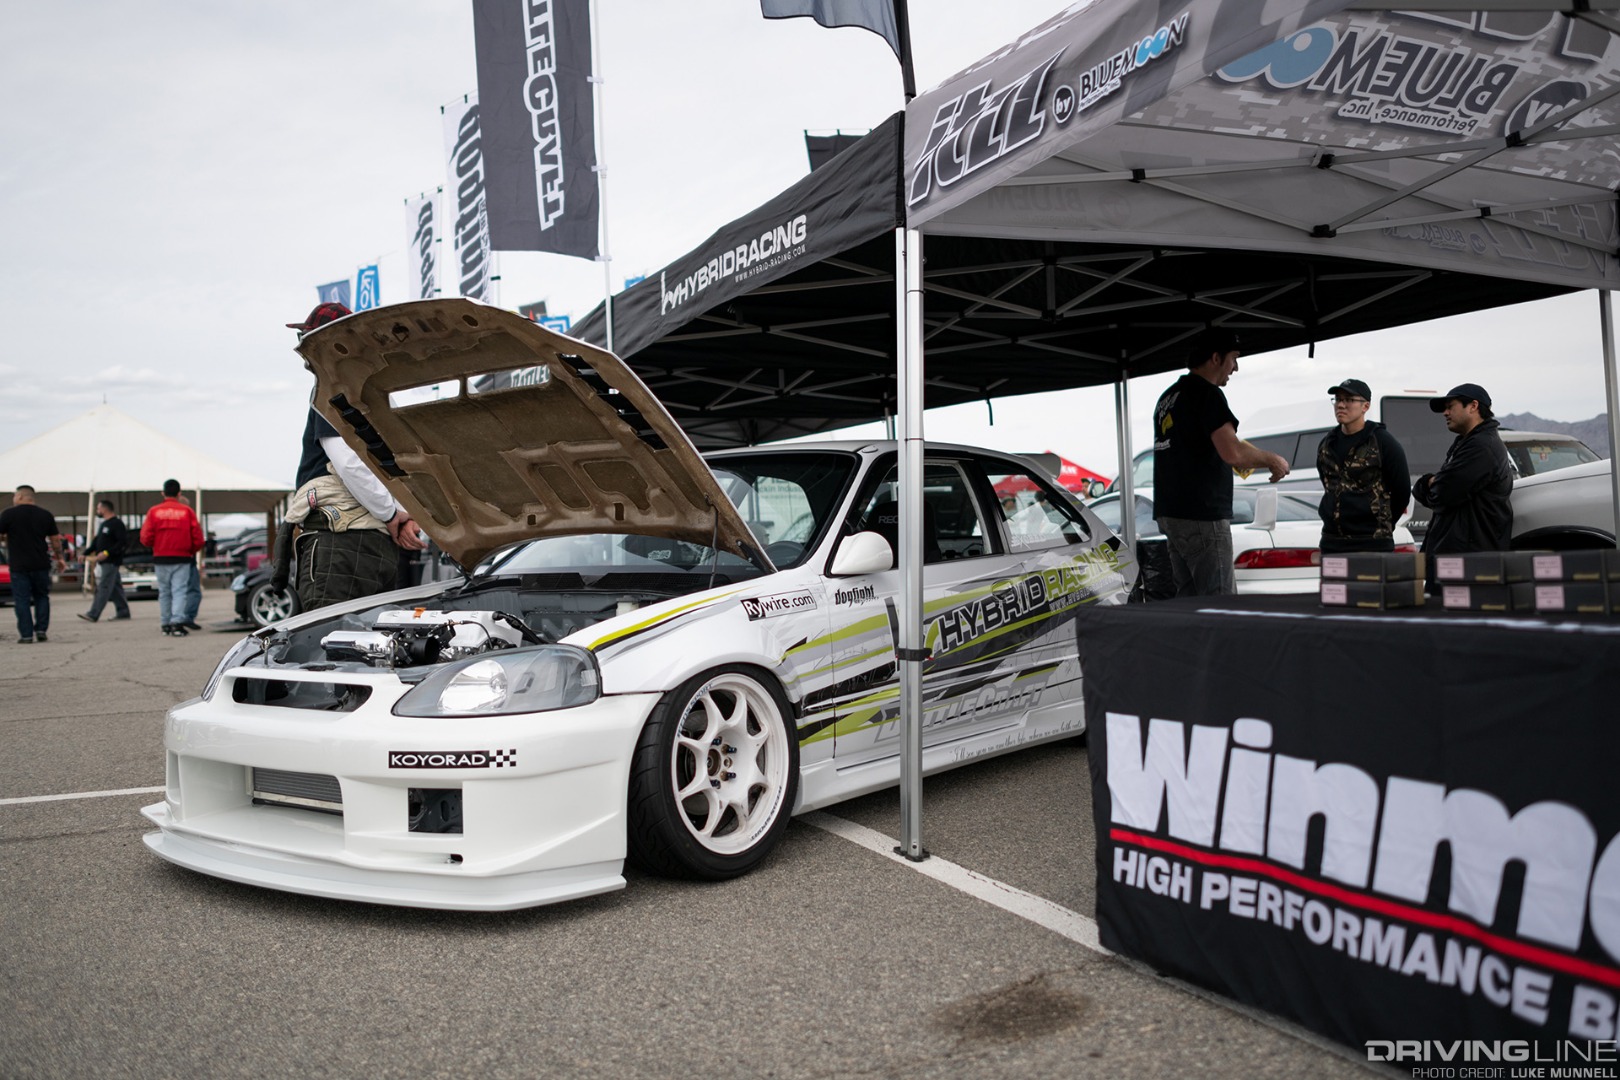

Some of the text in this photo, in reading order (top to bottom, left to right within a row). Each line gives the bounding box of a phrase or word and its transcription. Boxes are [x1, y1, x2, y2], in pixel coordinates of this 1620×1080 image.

[744, 594, 815, 617] Rywire.com
[834, 584, 874, 608] dogfight
[391, 754, 486, 766] KOYORAD
[1113, 846, 1620, 1053] HIGH PERFORMANCE B
